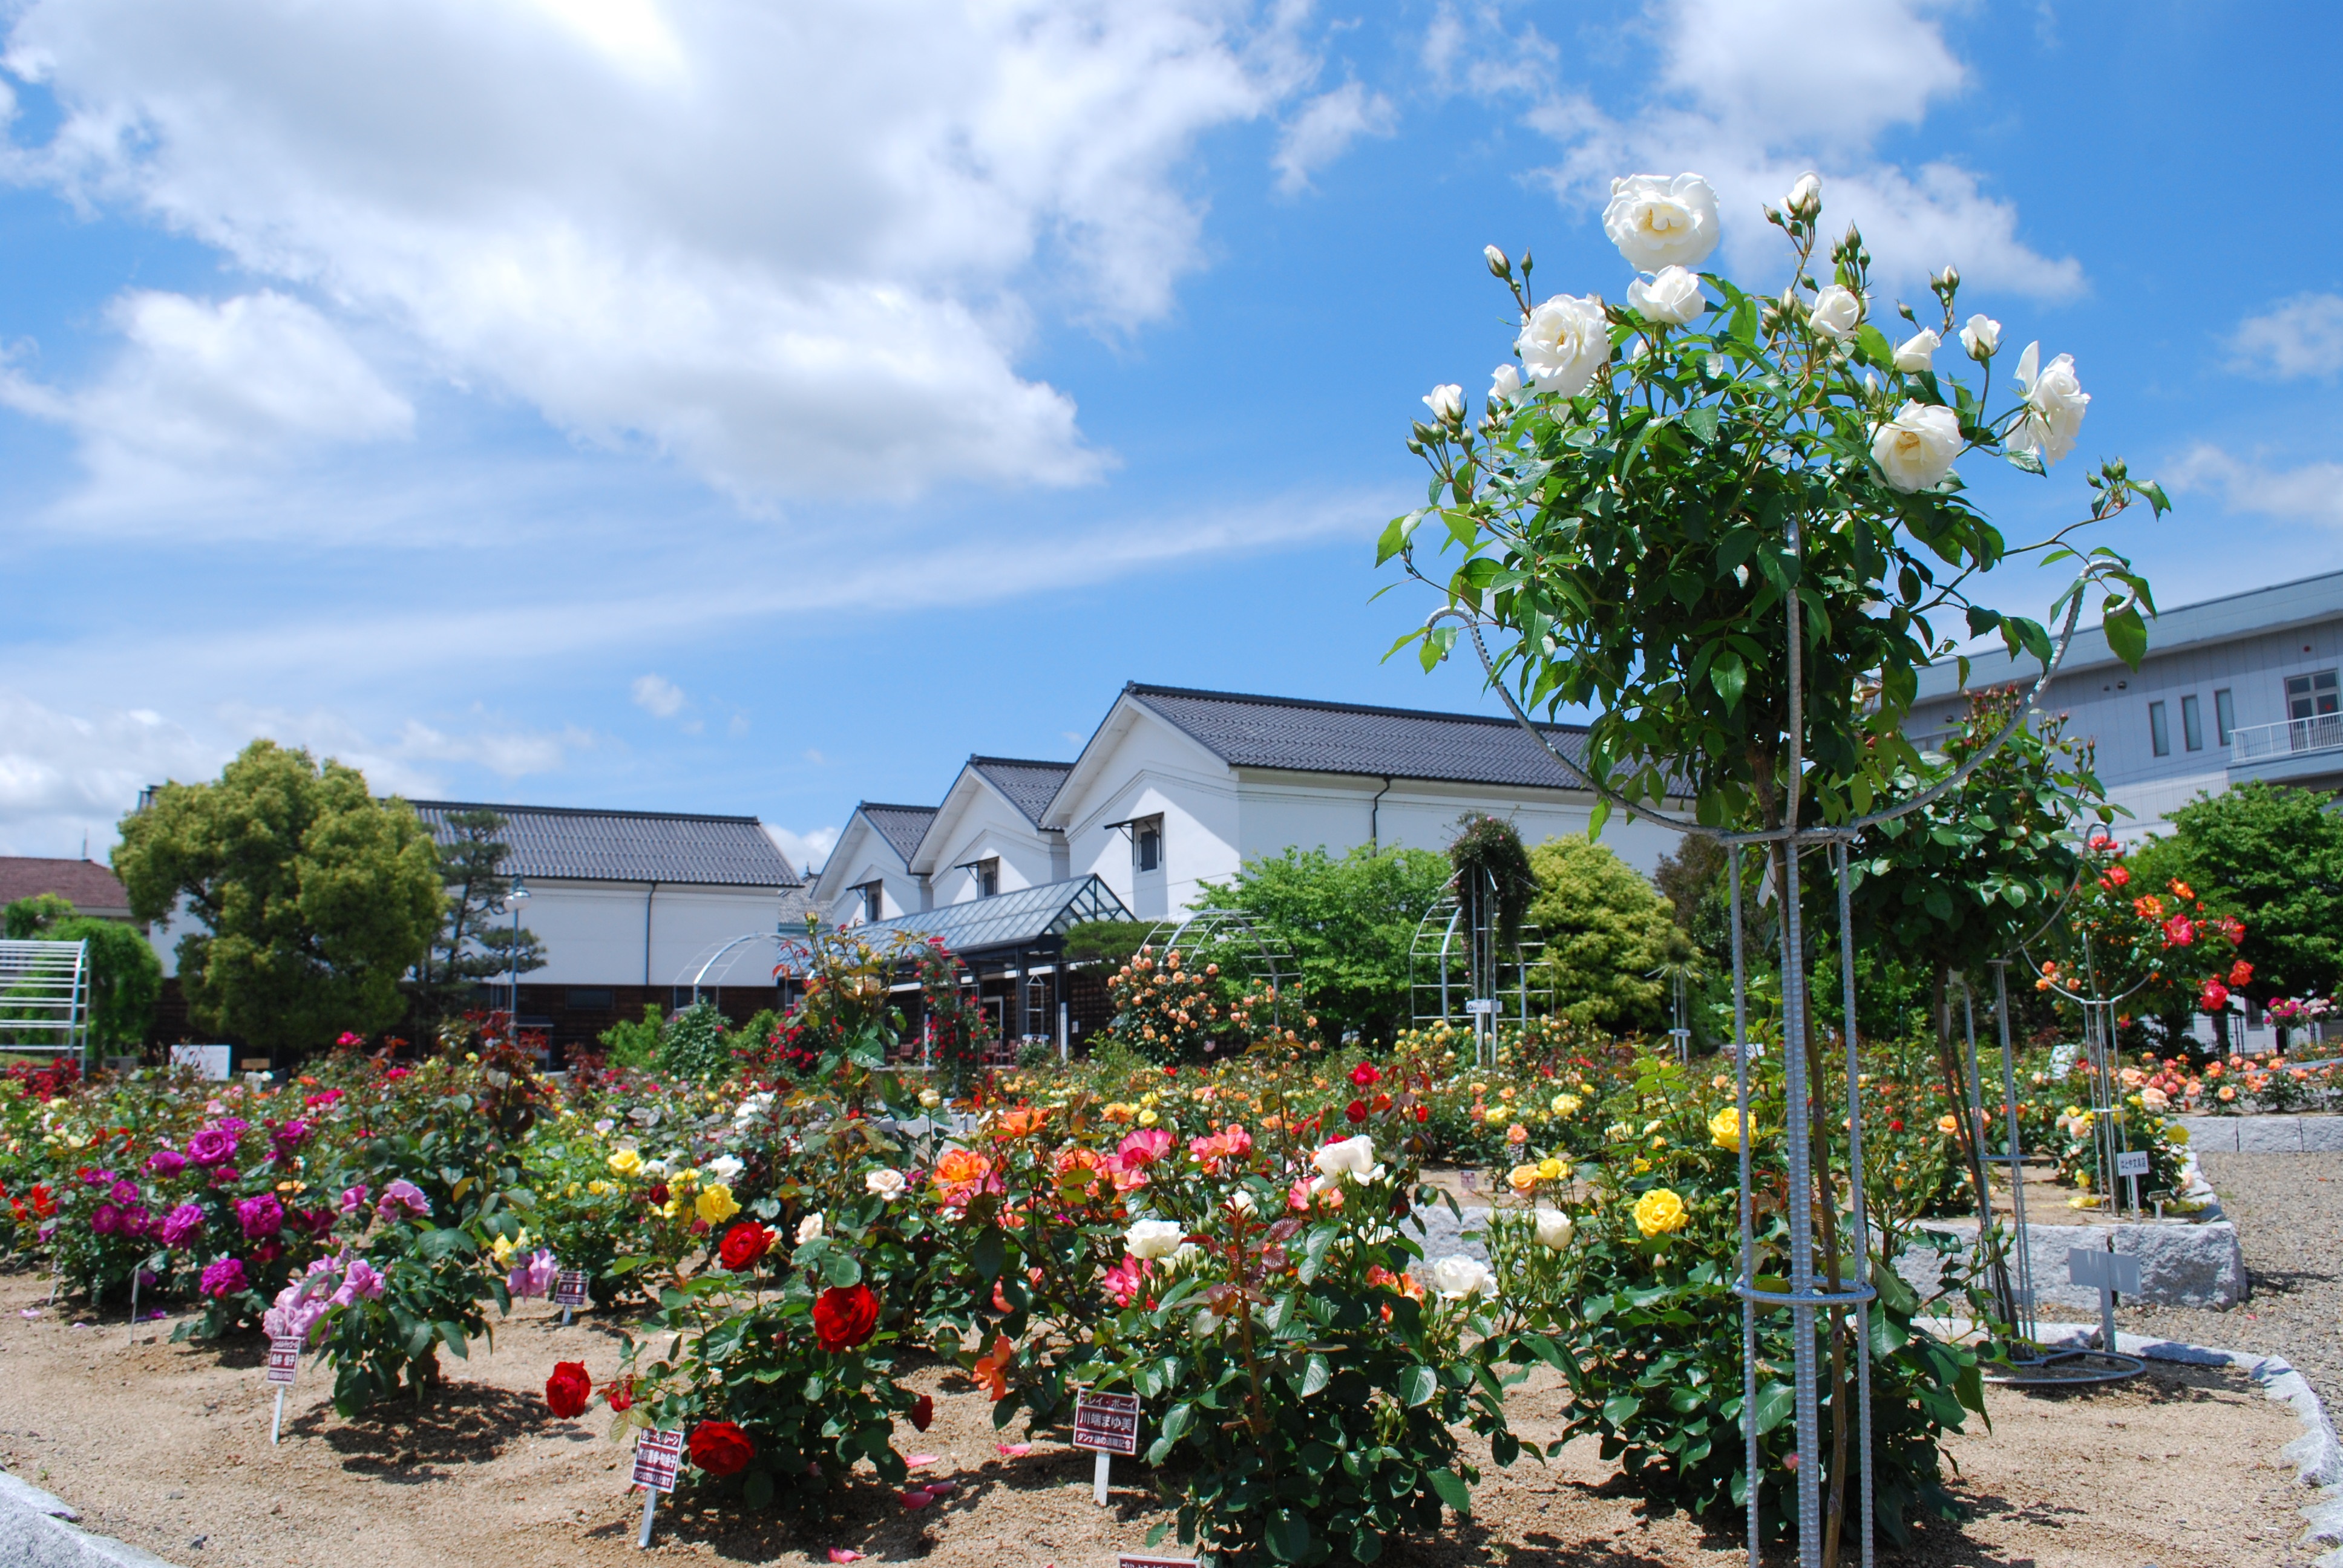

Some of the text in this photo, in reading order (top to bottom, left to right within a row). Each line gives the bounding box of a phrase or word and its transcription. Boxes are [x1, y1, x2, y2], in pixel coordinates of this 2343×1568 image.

[1080, 1411, 1132, 1432] 川端まゆ美
